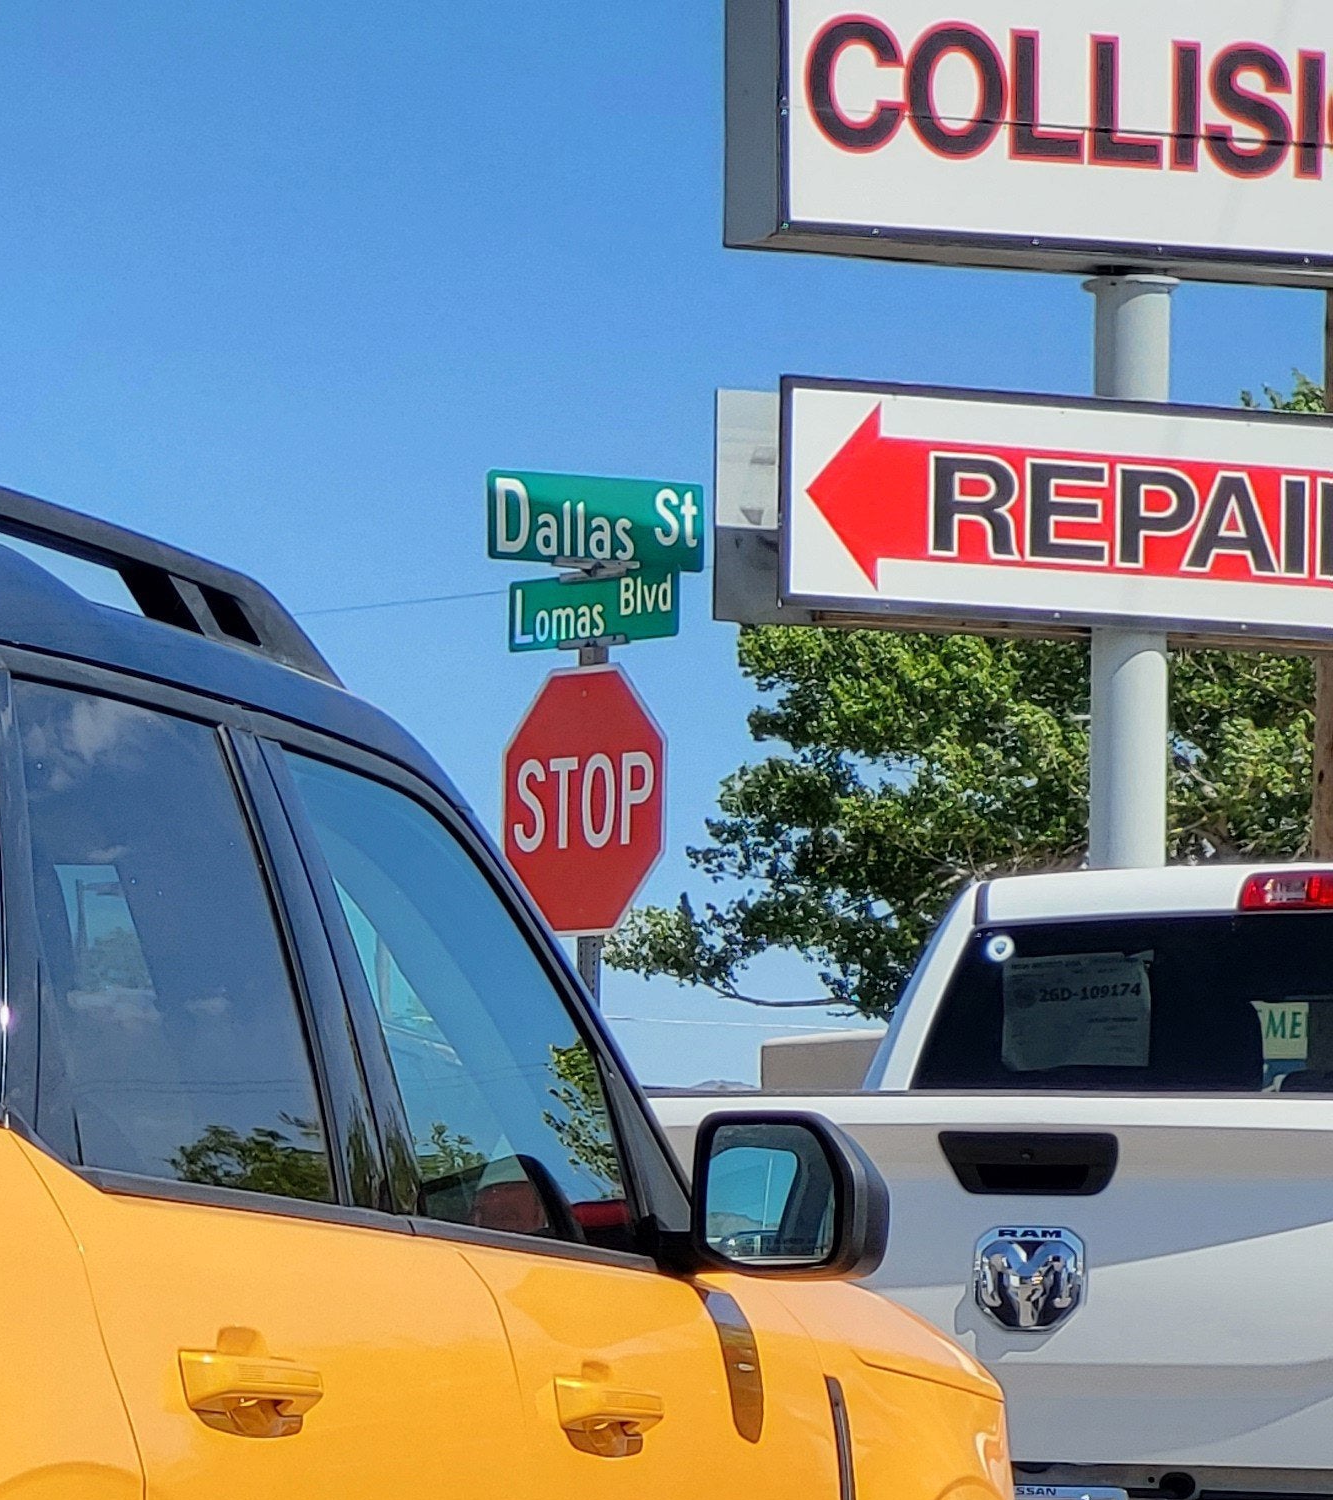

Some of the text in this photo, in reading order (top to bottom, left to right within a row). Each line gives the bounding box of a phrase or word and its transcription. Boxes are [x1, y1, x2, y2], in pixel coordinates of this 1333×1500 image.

[806, 13, 1333, 180] COLLISI
[495, 477, 699, 561] Dallas St
[927, 450, 1333, 582] REPAI
[514, 573, 672, 644] Lomas Blvd
[513, 751, 655, 853] STOP
[998, 1229, 1062, 1239] RAM
[1015, 1487, 1057, 1496] SSAN
